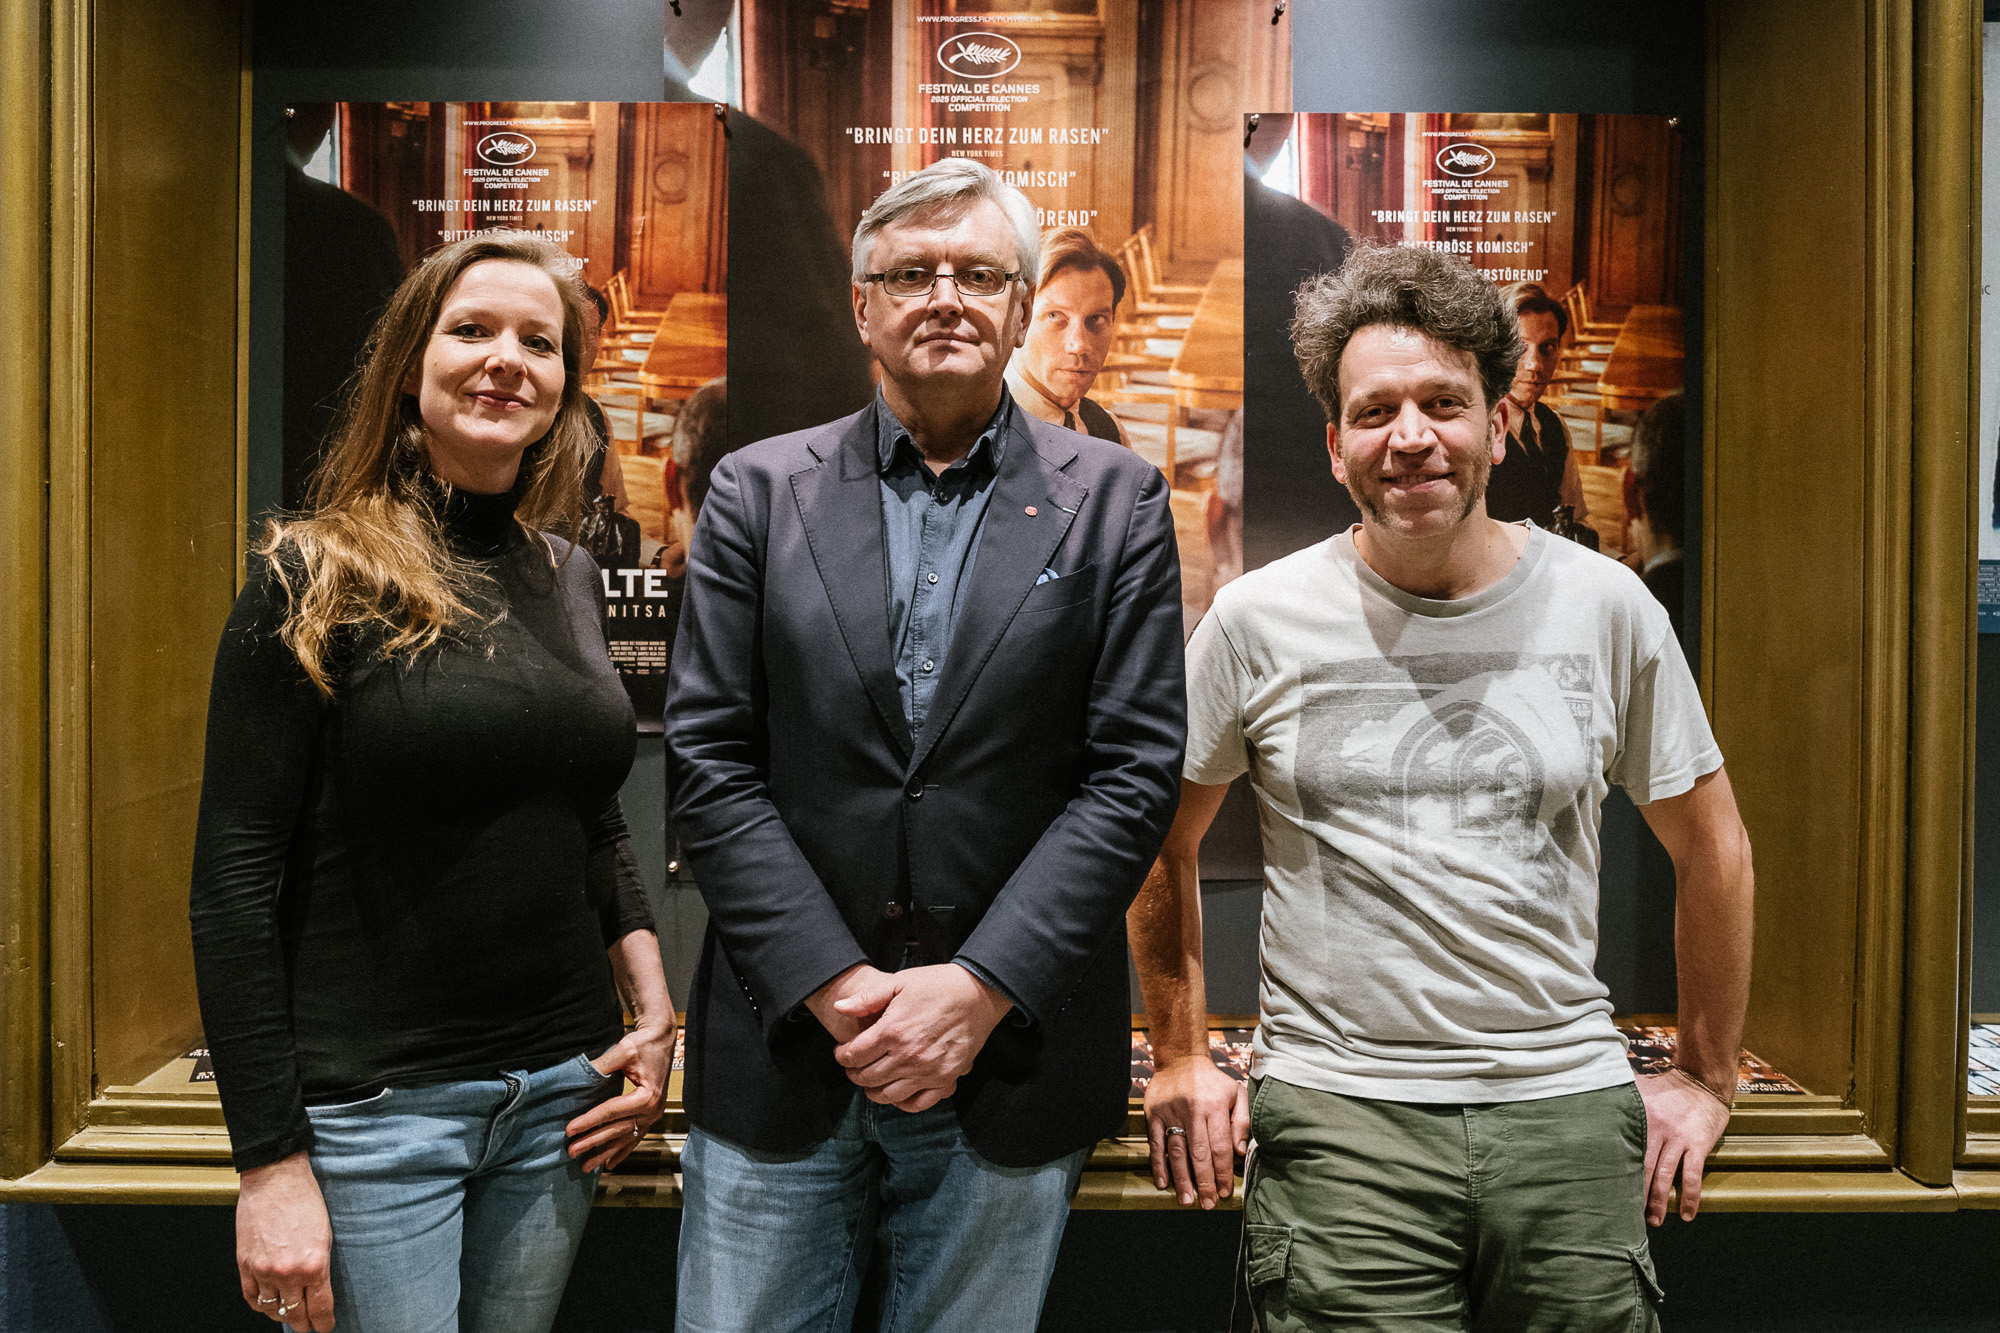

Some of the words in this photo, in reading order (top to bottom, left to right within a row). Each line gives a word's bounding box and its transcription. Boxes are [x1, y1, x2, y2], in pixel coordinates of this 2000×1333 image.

[918, 84, 972, 94] FESTIVAL
[974, 84, 989, 94] DE
[992, 84, 1040, 94] CANNES
[948, 104, 1010, 112] COMPETITION
[846, 128, 914, 145] “BRINGT
[919, 128, 957, 145] DEIN
[962, 128, 1004, 145] HERZ
[1009, 128, 1043, 145] ZUM
[1049, 128, 1109, 145] RASEN”
[412, 200, 460, 212] “BRINGT
[463, 200, 491, 212] DEIN
[494, 200, 523, 212] HERZ
[526, 200, 551, 212] ZUM
[554, 200, 598, 212] RASEN”
[1371, 210, 1419, 223] “BRINGT
[1423, 210, 1450, 223] DEIN
[1453, 210, 1483, 223] HERZ
[1486, 210, 1511, 223] ZUM
[1514, 210, 1557, 223] RASEN”
[1476, 241, 1534, 254] KOMISCH”
